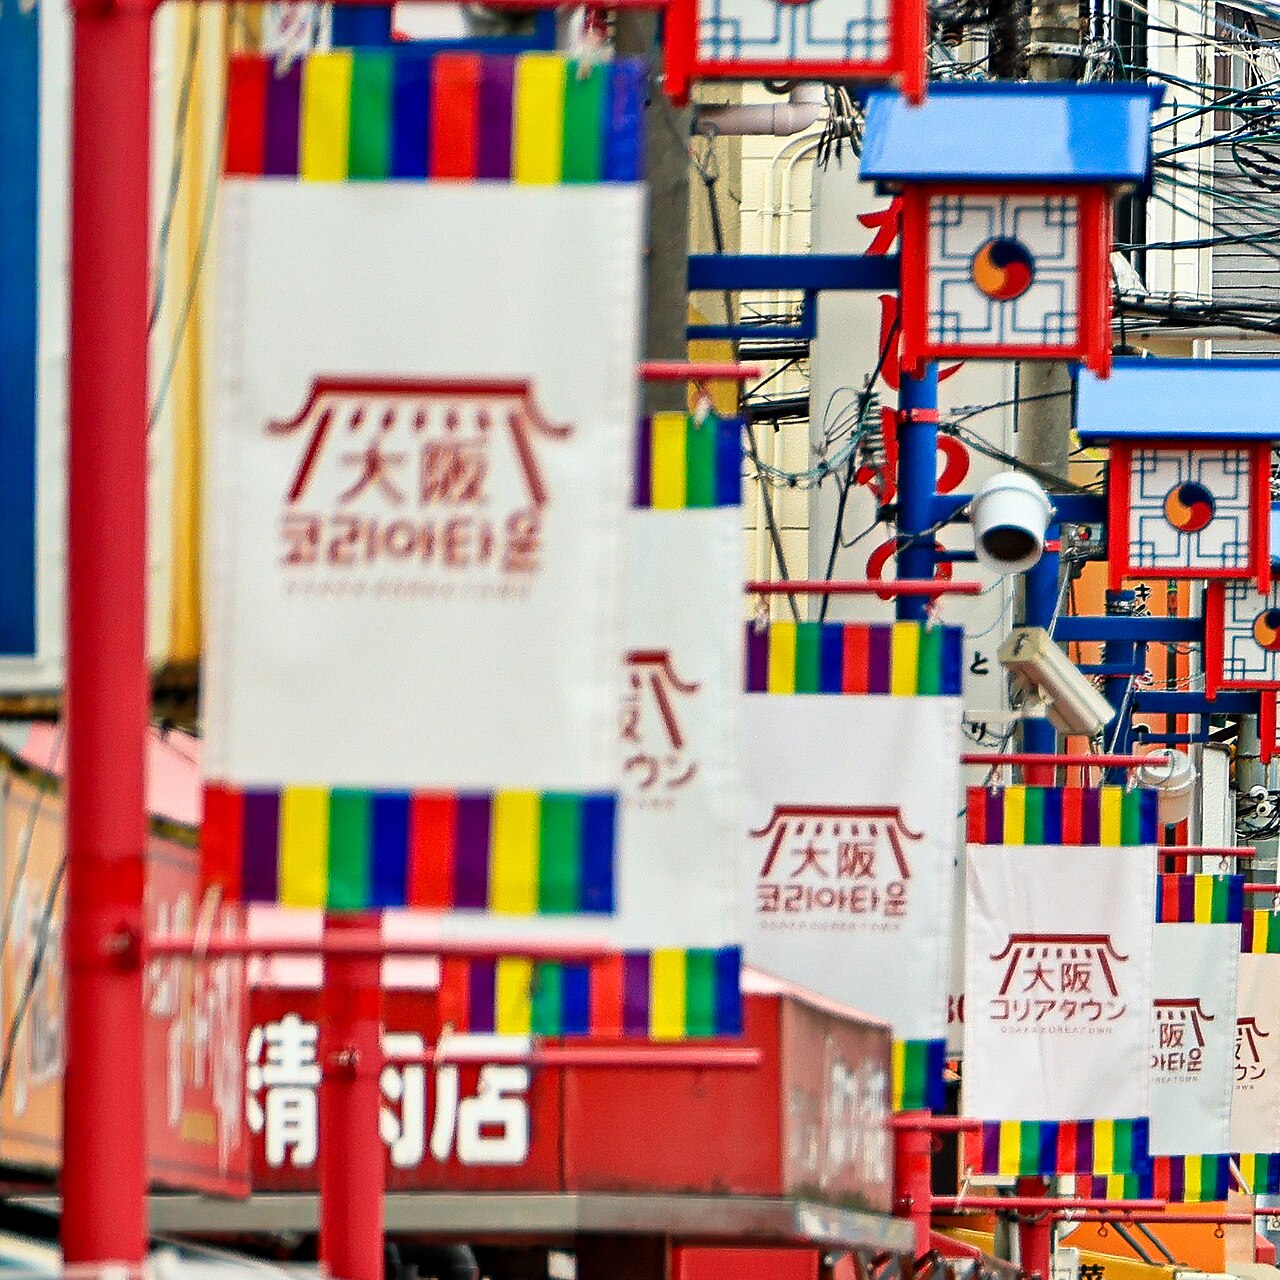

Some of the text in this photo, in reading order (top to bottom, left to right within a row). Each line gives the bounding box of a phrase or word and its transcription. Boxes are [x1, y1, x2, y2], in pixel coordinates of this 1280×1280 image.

[341, 437, 489, 503] 大阪
[279, 508, 541, 574] 코리아타운
[789, 841, 877, 880] 大阪
[757, 880, 909, 917] 코리아타운
[1023, 962, 1092, 993] 大阪
[989, 1000, 1128, 1022] コリアタウン
